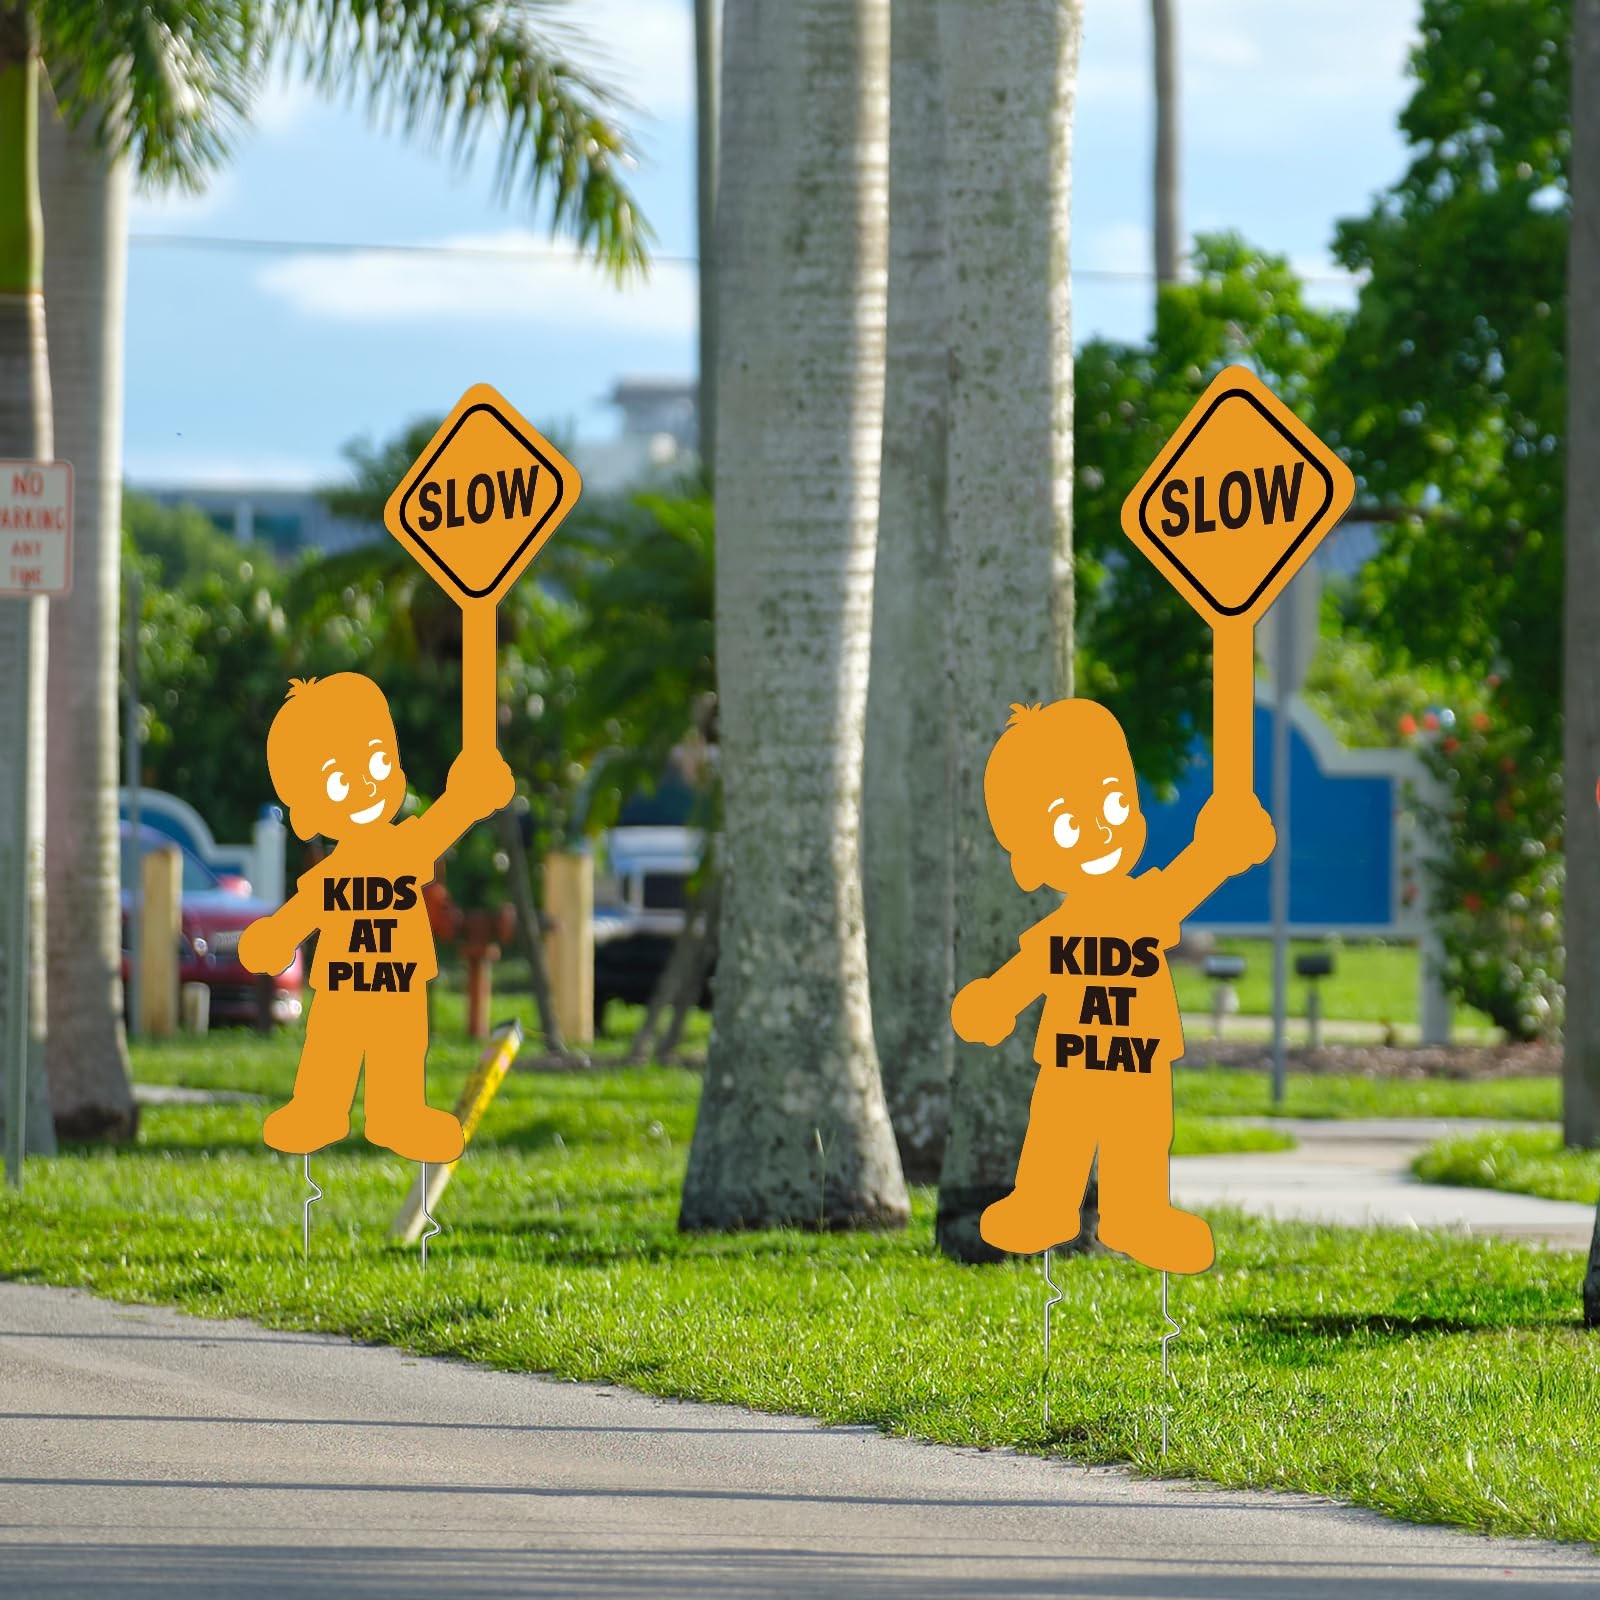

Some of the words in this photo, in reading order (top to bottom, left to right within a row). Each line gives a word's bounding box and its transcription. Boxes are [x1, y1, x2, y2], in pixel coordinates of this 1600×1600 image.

[11, 471, 44, 497] NO
[419, 465, 540, 532] SLOW
[1161, 462, 1305, 537] SLOW
[0, 506, 65, 530] ARKING
[323, 875, 418, 911] KIDS
[348, 918, 398, 953] AT
[1050, 936, 1160, 977] KIDS
[328, 961, 418, 993] PLAY
[1079, 985, 1136, 1026] AT
[1056, 1033, 1160, 1074] PLAY
